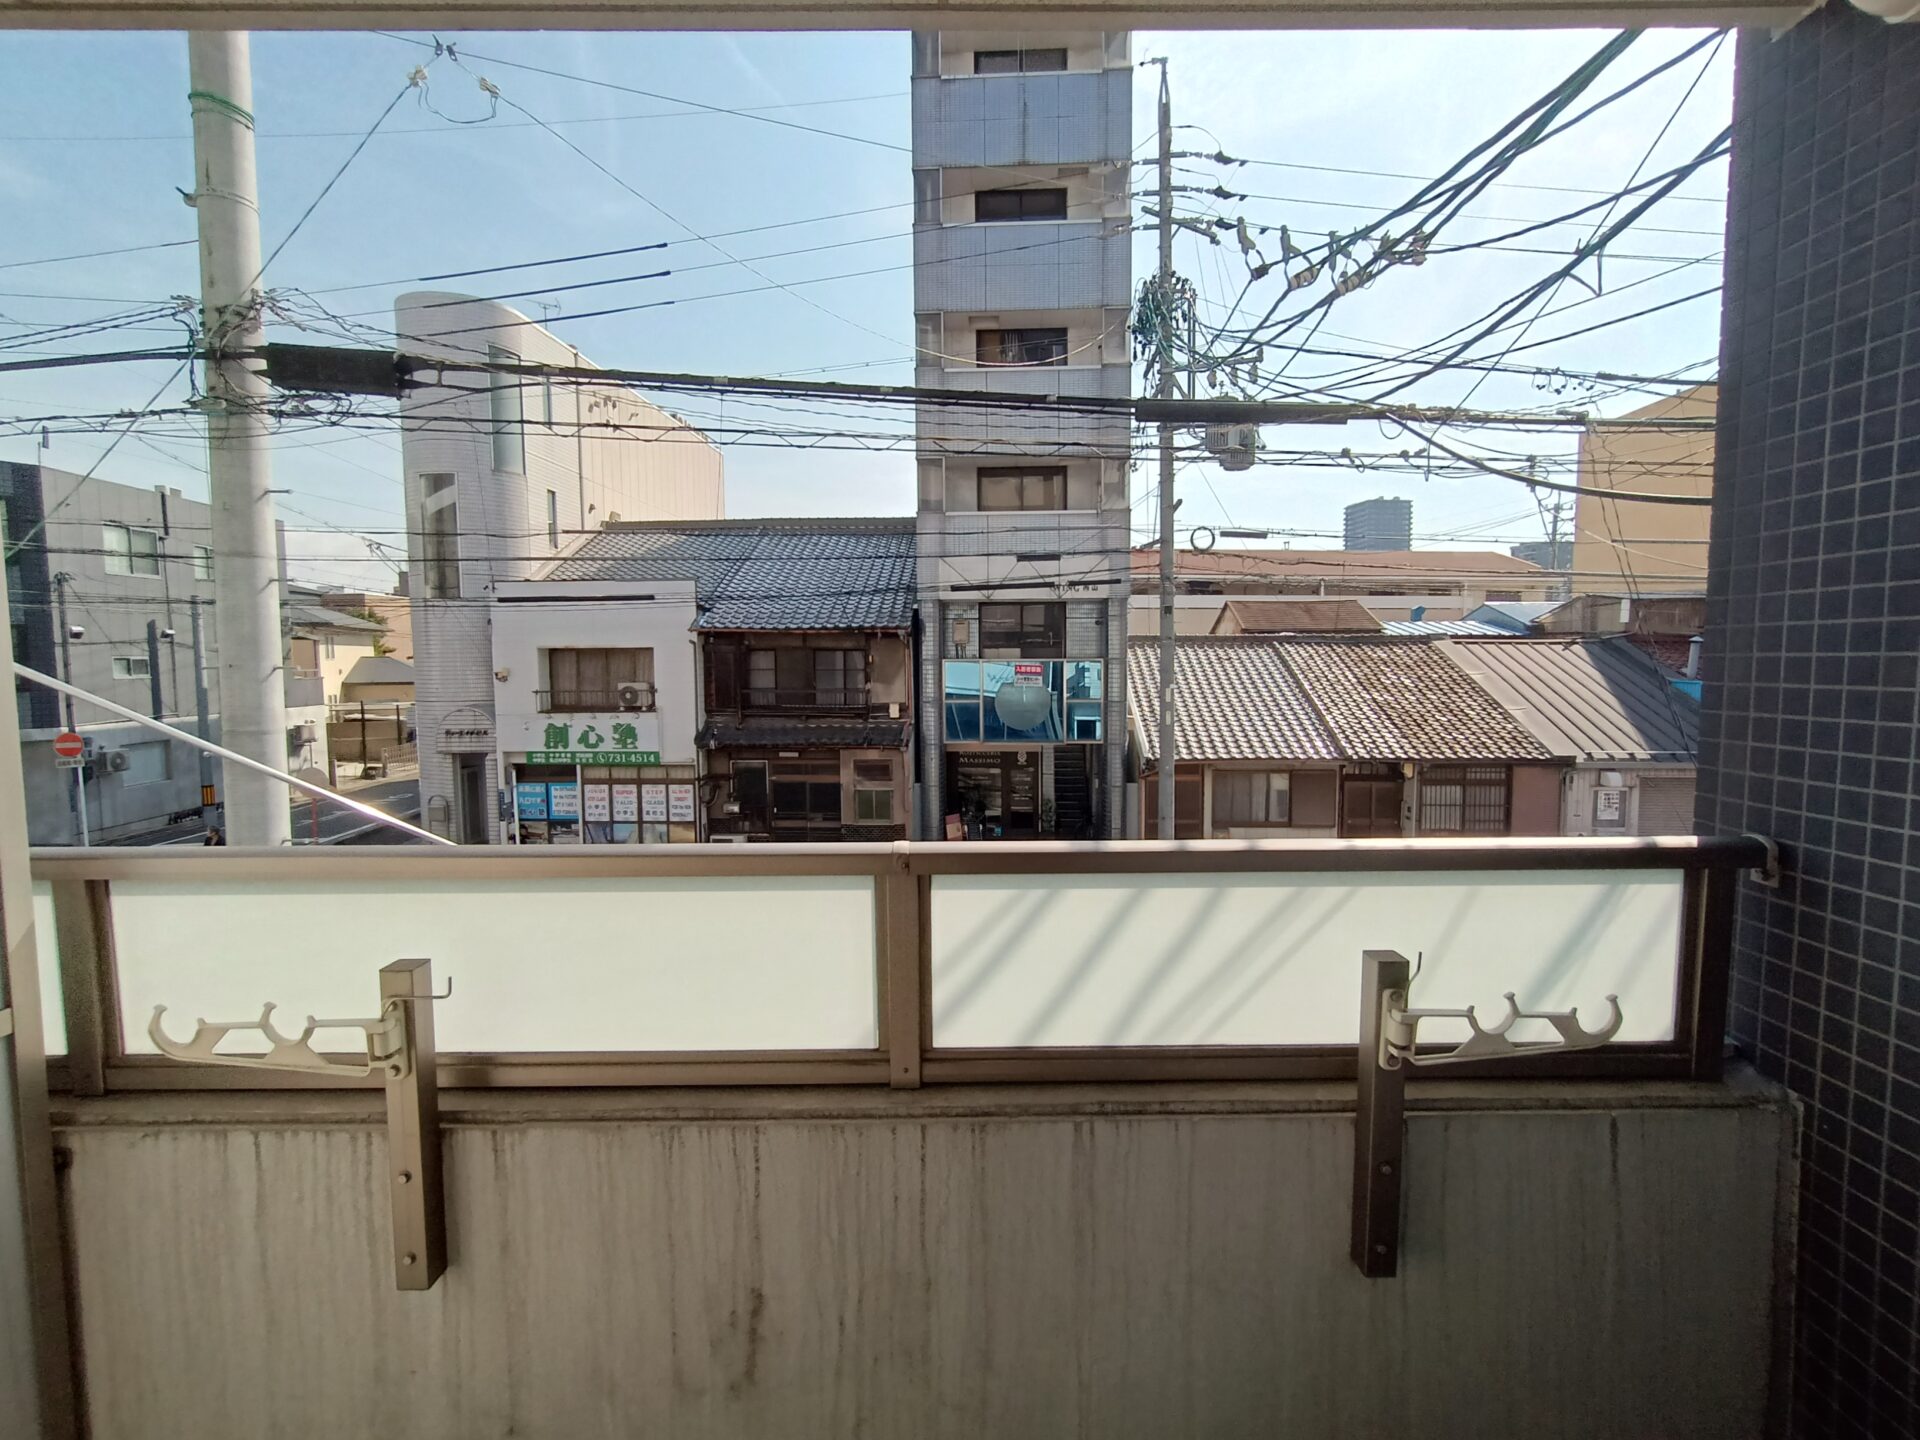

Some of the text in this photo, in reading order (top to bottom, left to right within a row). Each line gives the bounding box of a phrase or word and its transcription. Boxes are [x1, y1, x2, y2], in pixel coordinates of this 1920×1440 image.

[544, 723, 638, 750] 創心塾
[608, 753, 655, 763] 731-4514
